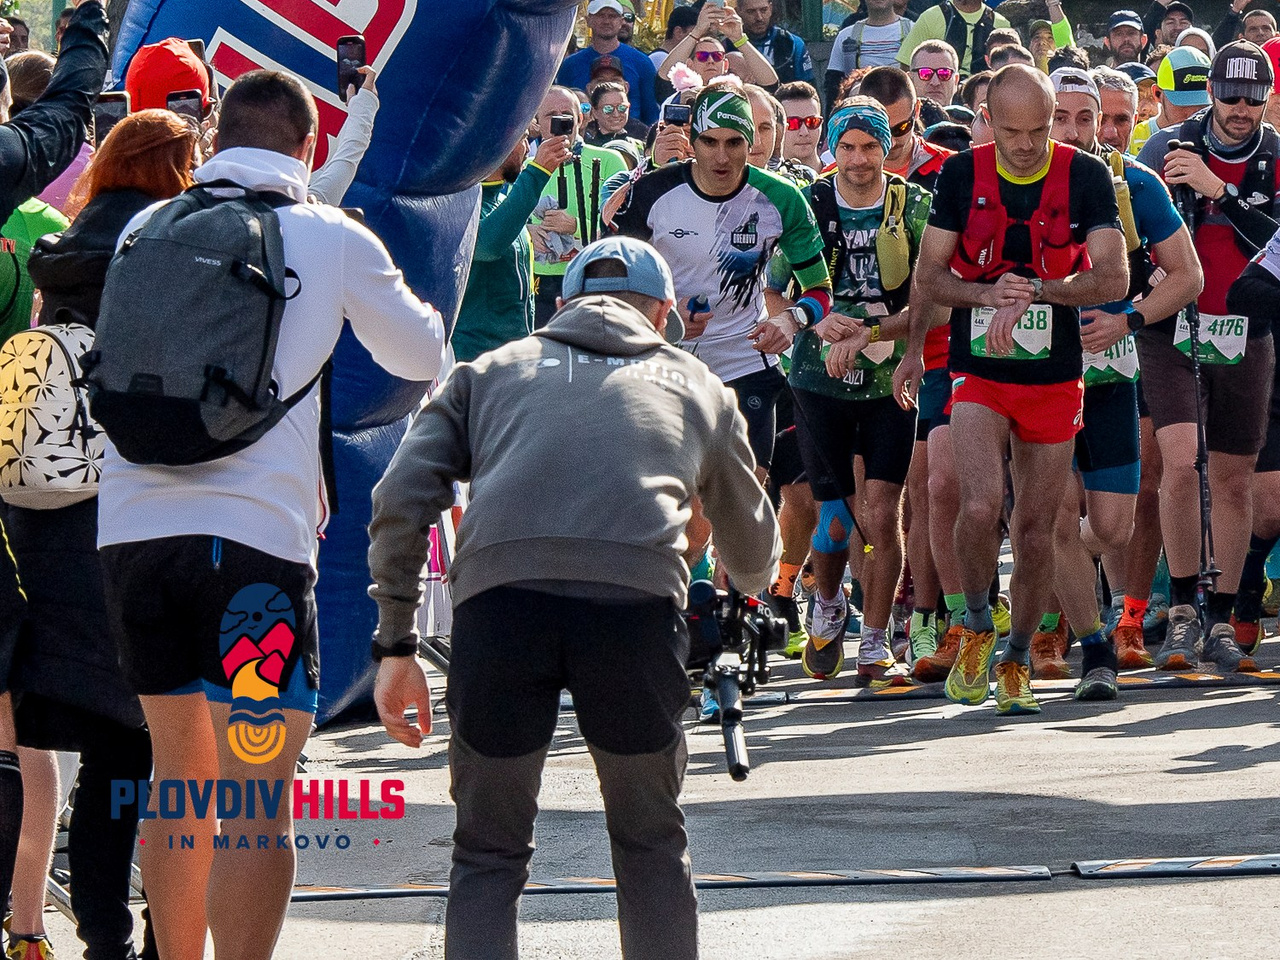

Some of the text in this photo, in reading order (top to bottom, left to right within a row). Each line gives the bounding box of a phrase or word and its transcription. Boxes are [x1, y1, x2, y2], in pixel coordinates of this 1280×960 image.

[195, 256, 221, 266] VIVESS
[1208, 318, 1246, 337] 4176
[843, 369, 864, 385] 2021
